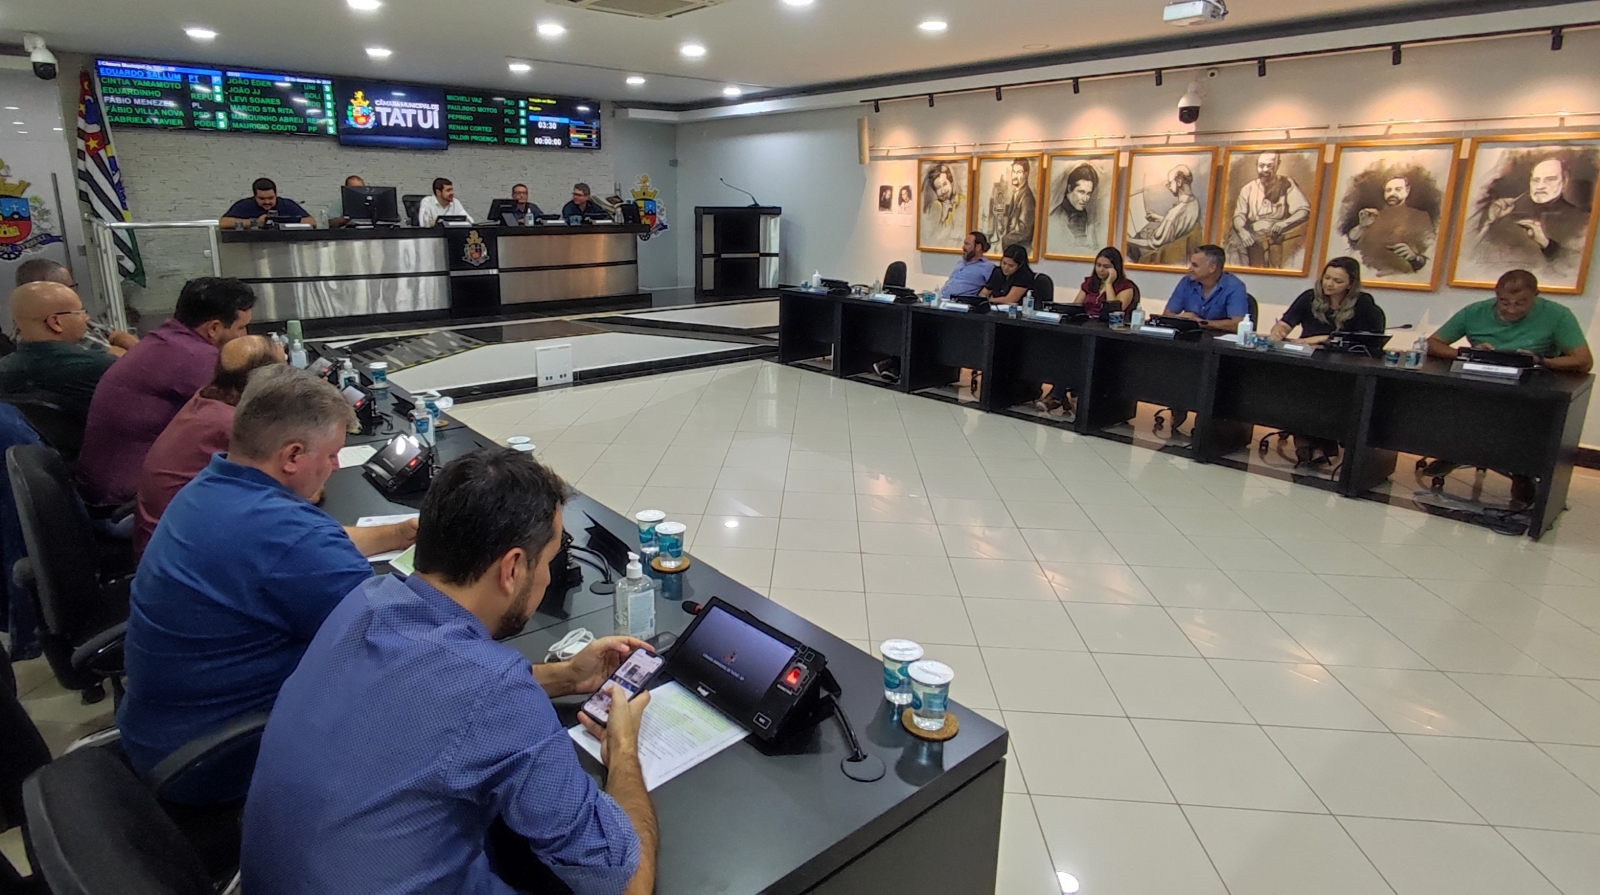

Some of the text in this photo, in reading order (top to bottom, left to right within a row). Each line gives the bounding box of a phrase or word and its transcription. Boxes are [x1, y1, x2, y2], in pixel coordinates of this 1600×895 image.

[100, 67, 144, 77] EDUARDO
[146, 70, 181, 80] SALLUM
[101, 77, 132, 86] CINTIA
[132, 79, 181, 89] YAMAMOTO
[102, 87, 162, 97] EDUARDINHO
[190, 92, 213, 100] REPU
[103, 95, 131, 105] FÁBIO
[229, 95, 248, 103] LEVI
[248, 97, 281, 105] SOARES
[106, 104, 133, 114] FÁBIO
[134, 107, 160, 116] VILLA
[161, 109, 185, 118] NOVA
[230, 104, 260, 112] MARCIO
[277, 107, 294, 115] RITA
[447, 104, 476, 112] PAULINHO
[477, 106, 498, 114] MOTOS
[107, 115, 151, 124] GABRIELA
[231, 113, 277, 122] MARQUINHO
[279, 116, 304, 124] ABREU
[374, 106, 439, 129] TATUÍ
[271, 124, 297, 132] COUTO
[469, 125, 492, 133] CORTEZ
[538, 121, 557, 129] 03:30
[448, 133, 469, 141] VALDIR
[470, 135, 498, 143] PROENÇA
[534, 137, 562, 145] 00:00:00
